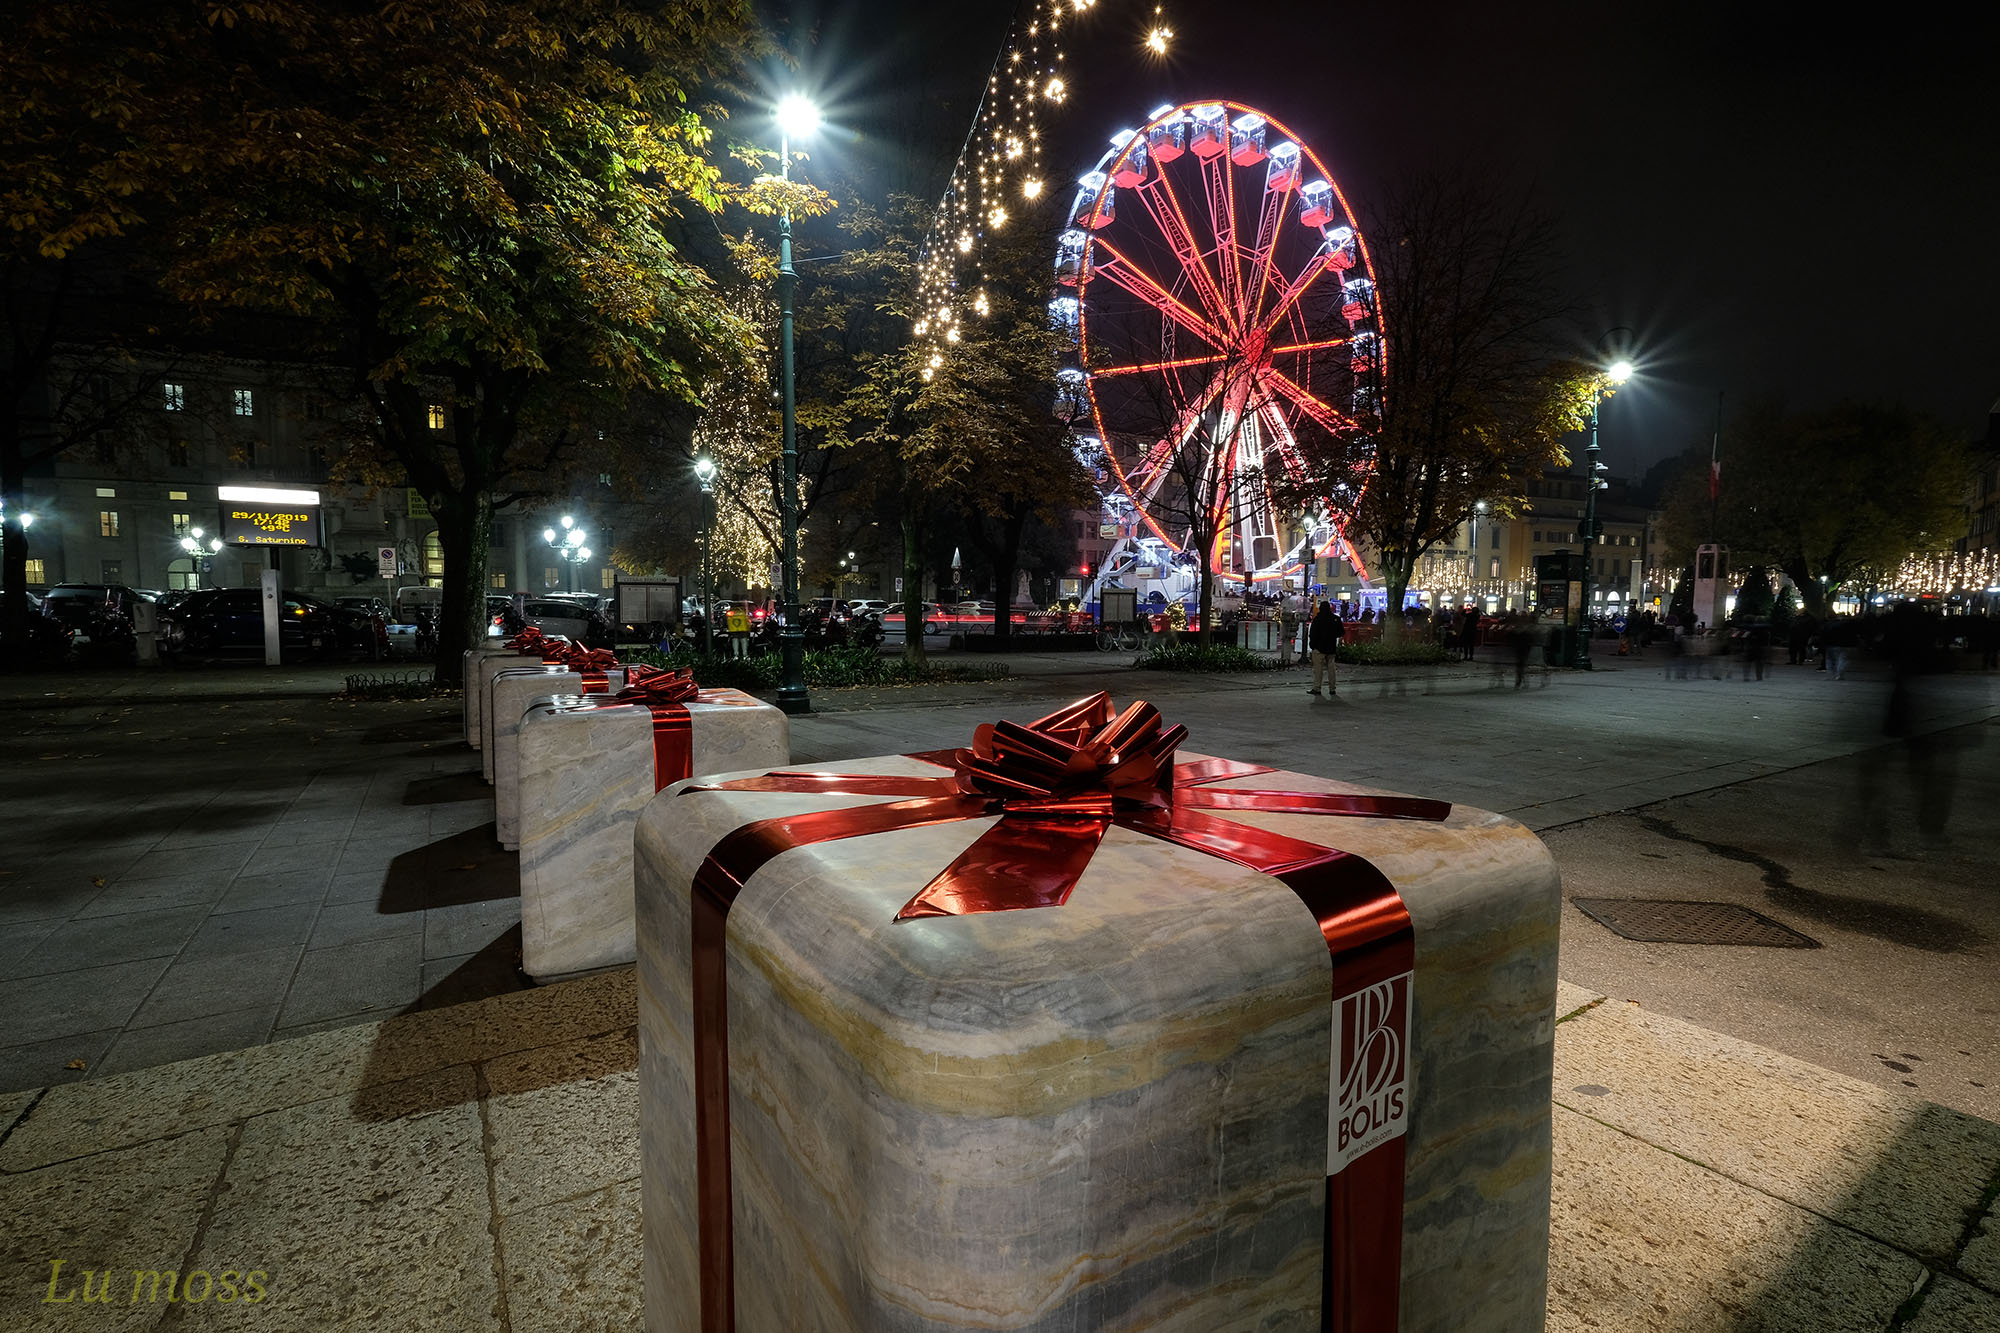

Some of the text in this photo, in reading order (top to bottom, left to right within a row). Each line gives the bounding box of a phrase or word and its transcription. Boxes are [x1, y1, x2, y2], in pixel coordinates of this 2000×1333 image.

[232, 511, 309, 521] 29/11/2019
[238, 535, 307, 545] S. Saturnino
[1338, 1088, 1404, 1153] BOLIS
